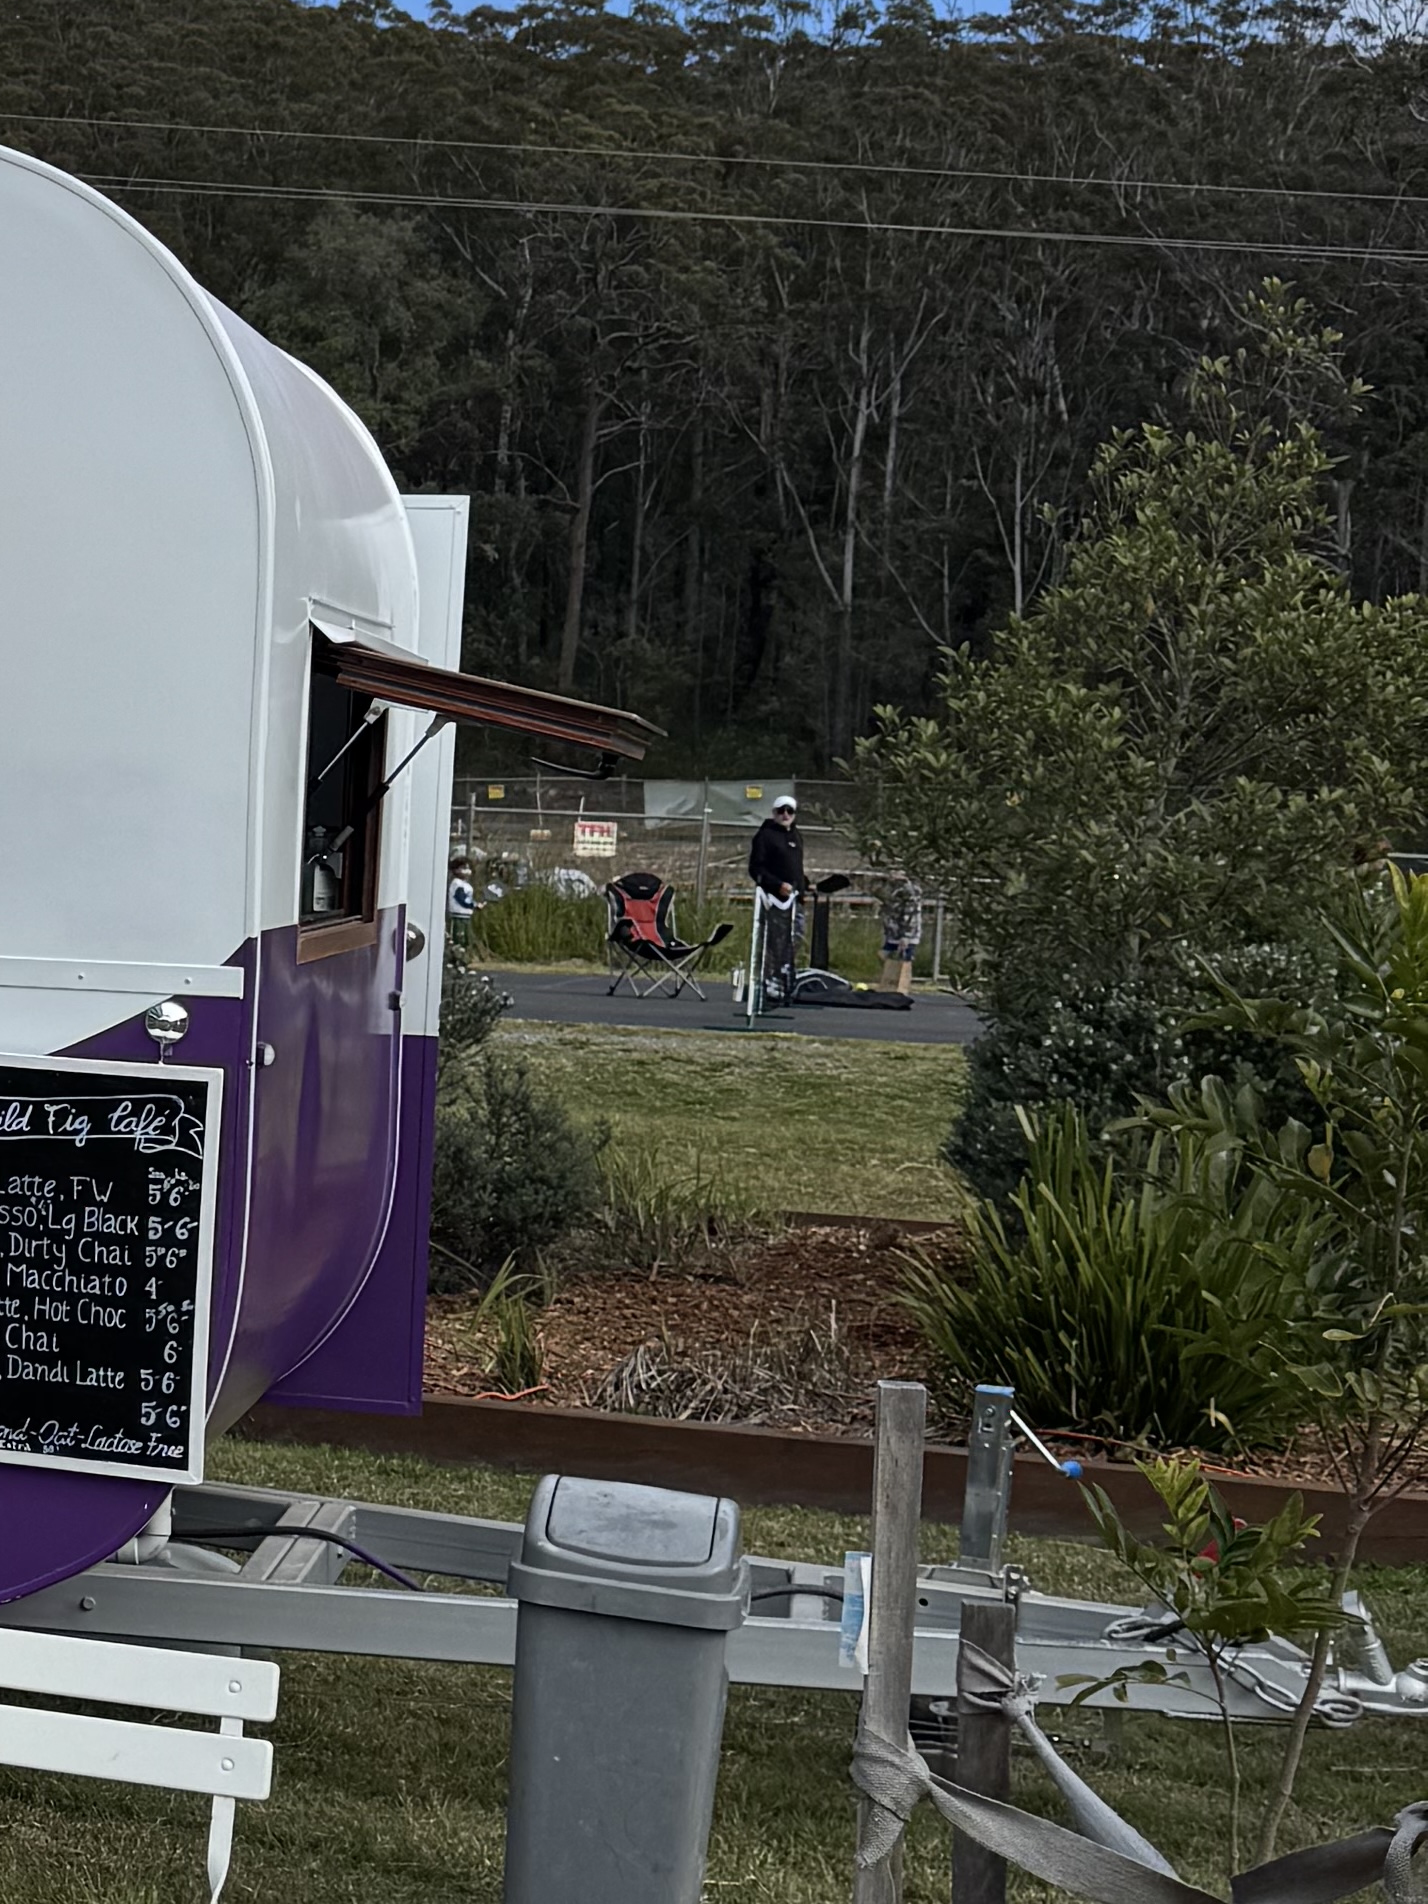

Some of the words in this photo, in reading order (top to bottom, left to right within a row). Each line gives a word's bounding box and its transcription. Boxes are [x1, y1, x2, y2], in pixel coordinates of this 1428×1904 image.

[44, 1103, 91, 1147] Fig
[83, 1206, 139, 1236] Black
[8, 1231, 66, 1270] Dirty
[78, 1237, 132, 1266] Chai
[7, 1262, 127, 1296] Macchiato
[34, 1296, 71, 1322] Hot
[77, 1298, 127, 1329] Choc
[5, 1323, 60, 1352] Chai
[6, 1354, 70, 1383] Dandi
[75, 1360, 125, 1390] Latte
